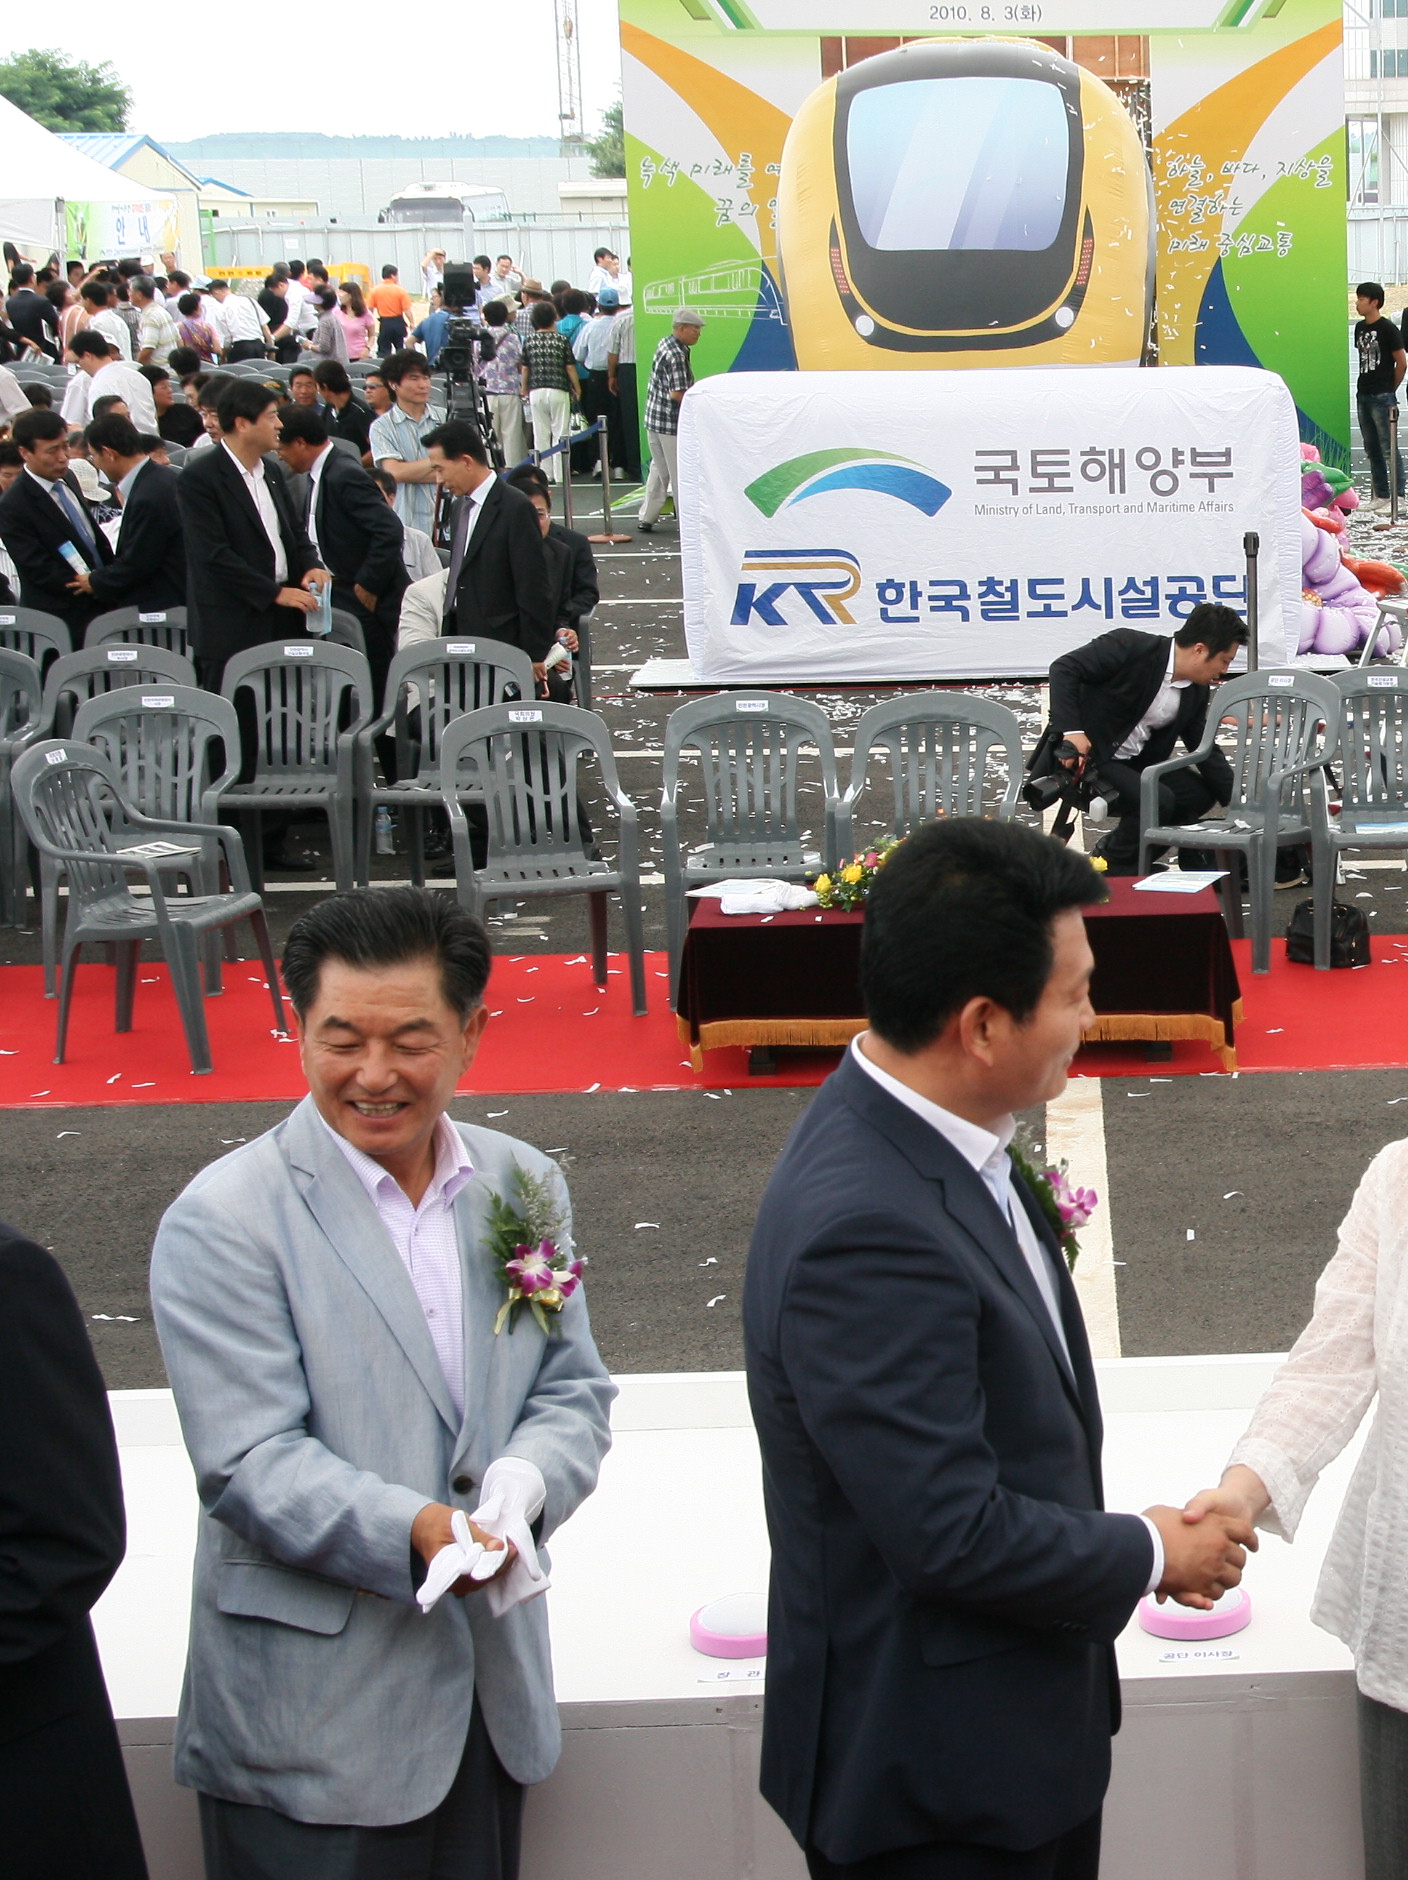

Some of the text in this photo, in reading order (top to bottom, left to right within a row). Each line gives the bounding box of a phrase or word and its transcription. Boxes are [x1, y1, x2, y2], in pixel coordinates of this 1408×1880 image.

[929, 4, 1042, 22] 2010. 8. 3(화)
[641, 157, 680, 188] 녹색
[690, 153, 754, 189] 미래를
[1168, 155, 1333, 188] 하늘, 바다, 지상을
[715, 198, 759, 227] 꿈의
[1170, 193, 1243, 224] 연결하는
[1168, 231, 1292, 257] 미래 중심교통
[974, 446, 1234, 496] 국토해양부
[974, 500, 1234, 518] Ministry of Land, Transport and Maritime Affairs
[730, 549, 861, 625] KR
